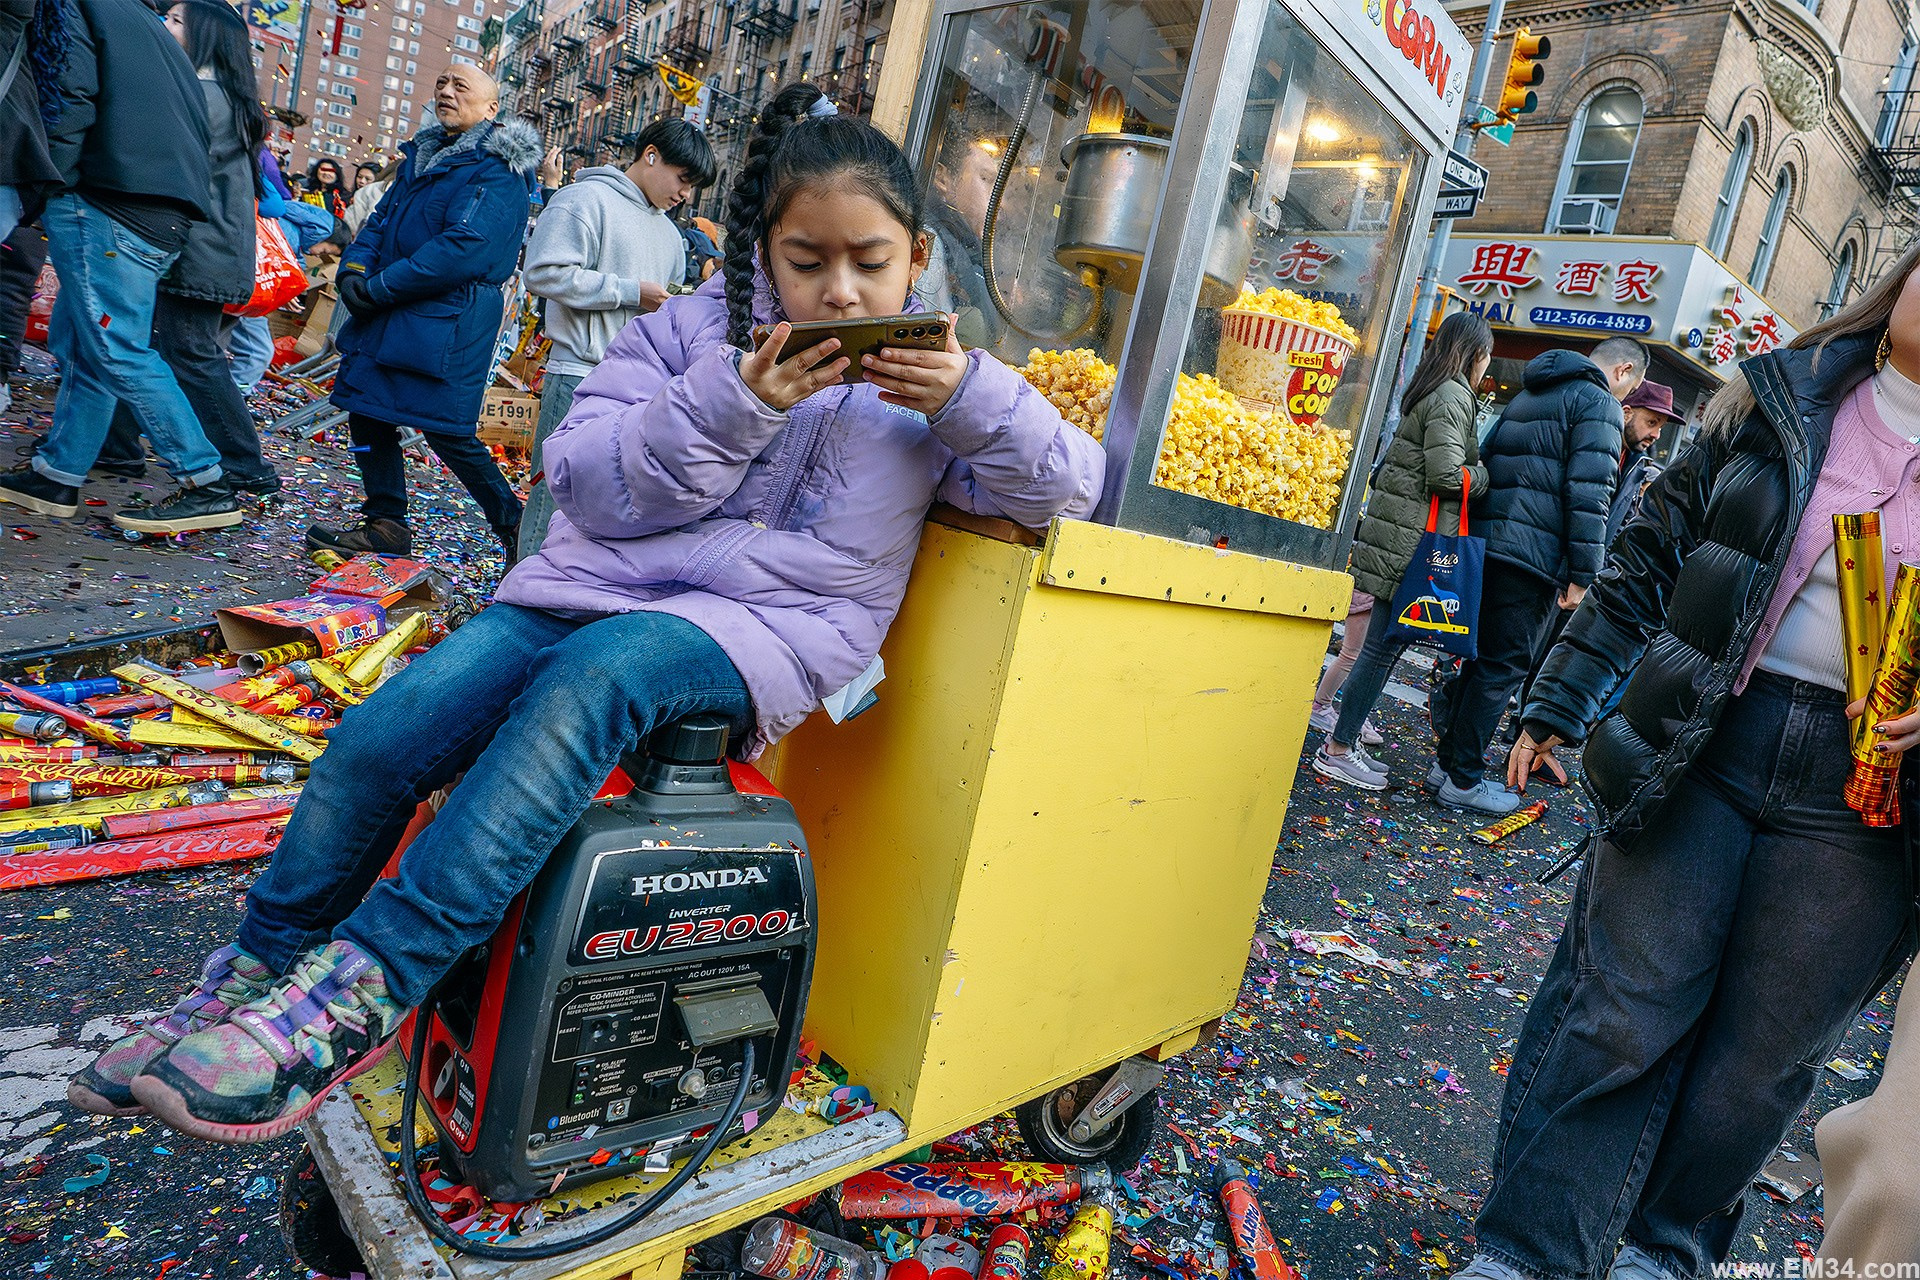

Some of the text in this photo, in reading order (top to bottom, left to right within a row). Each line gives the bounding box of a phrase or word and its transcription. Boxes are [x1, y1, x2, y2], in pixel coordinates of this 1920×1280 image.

[1449, 161, 1482, 187] ONE WAY
[1445, 198, 1469, 210] WAY
[1532, 308, 1647, 331] 212-566-4884
[1291, 353, 1323, 367] Fresh
[1302, 370, 1338, 394] POP
[885, 405, 915, 419] FACE
[335, 620, 378, 645] PARTY
[149, 838, 259, 855] PARTY
[631, 867, 768, 896] HONDA
[687, 963, 750, 980] AC OUT 120V 15A
[589, 988, 636, 1001] CO-MINDER
[558, 1027, 576, 1035] RESET
[460, 1058, 470, 1074] ON
[559, 1109, 601, 1126] Bluetooth
[455, 1127, 465, 1141] OFF
[1239, 1202, 1260, 1253] PARTY
